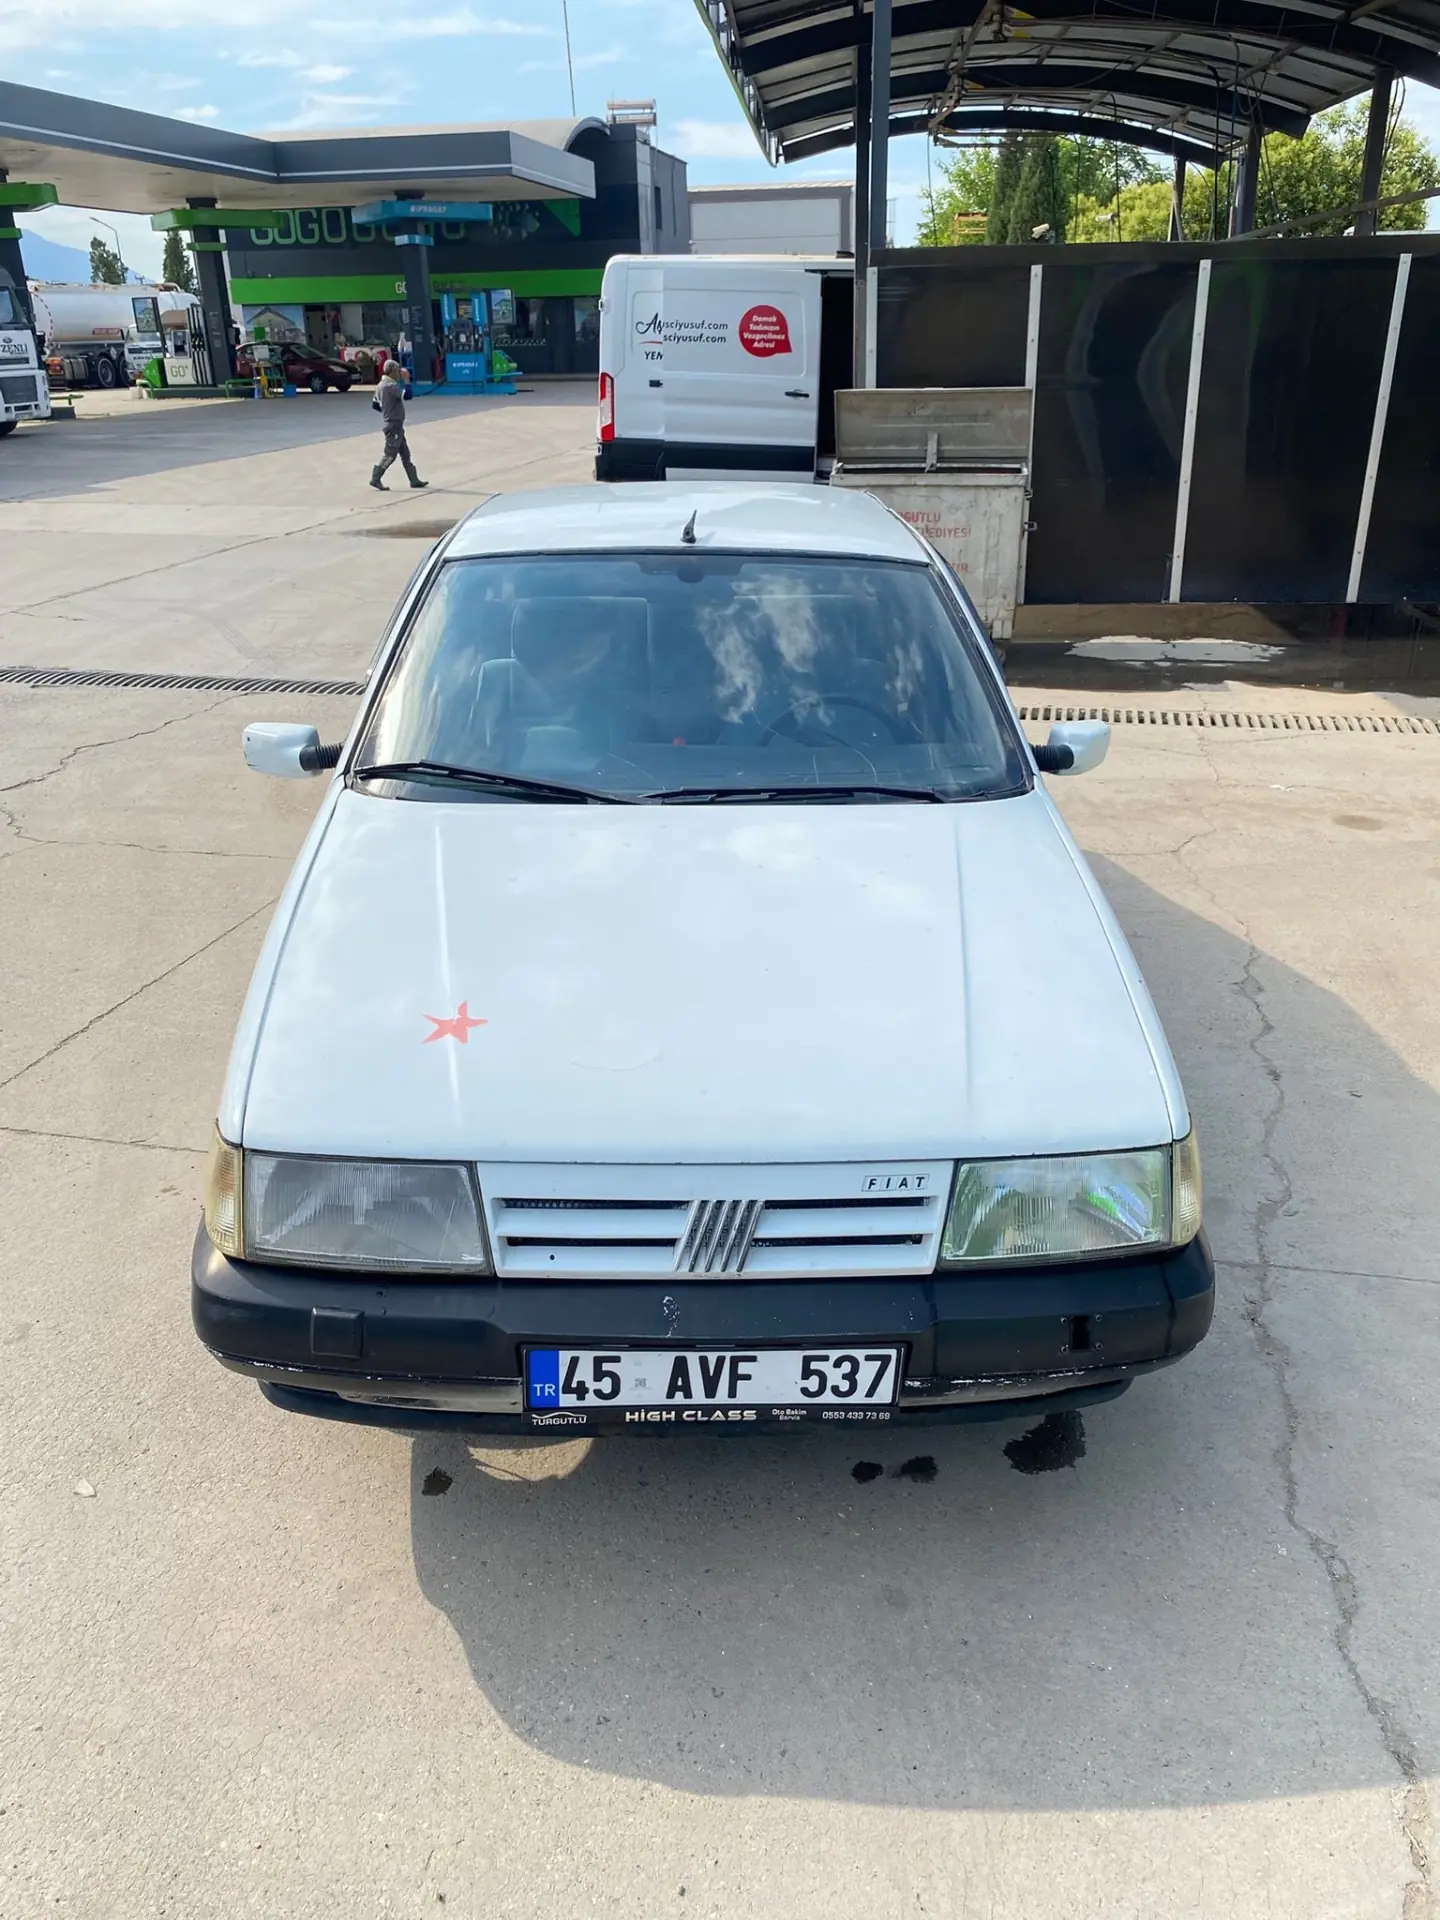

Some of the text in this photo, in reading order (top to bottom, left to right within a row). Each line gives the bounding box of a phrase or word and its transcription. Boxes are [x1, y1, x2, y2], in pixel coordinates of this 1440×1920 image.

[867, 1176, 925, 1190] FIAT
[533, 1353, 893, 1401] TR 45 AVF 537
[532, 1415, 587, 1426] TURGUTLU
[682, 1410, 758, 1421] CLASS
[822, 1411, 845, 1420] 0553
[846, 1412, 864, 1420] 433
[865, 1412, 878, 1420] 73
